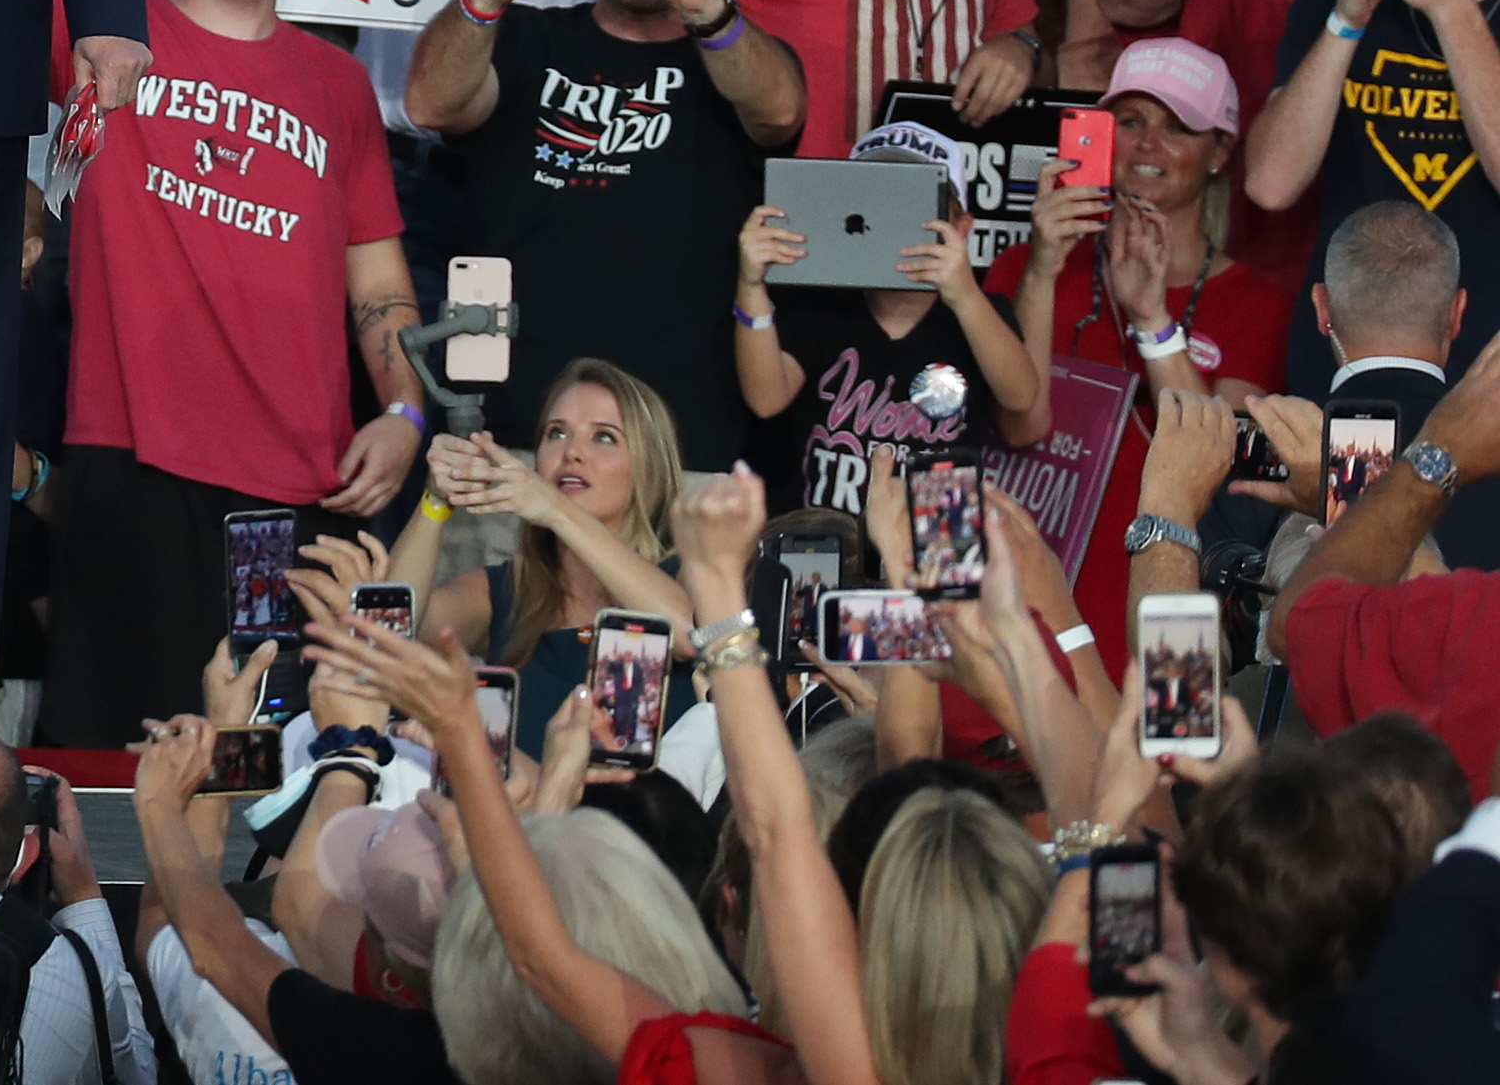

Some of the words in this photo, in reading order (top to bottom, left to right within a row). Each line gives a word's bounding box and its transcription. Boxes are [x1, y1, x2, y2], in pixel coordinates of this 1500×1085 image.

[135, 75, 328, 179] WESTERN
[145, 163, 300, 242] KENTUCKY
[1413, 153, 1449, 182] M
